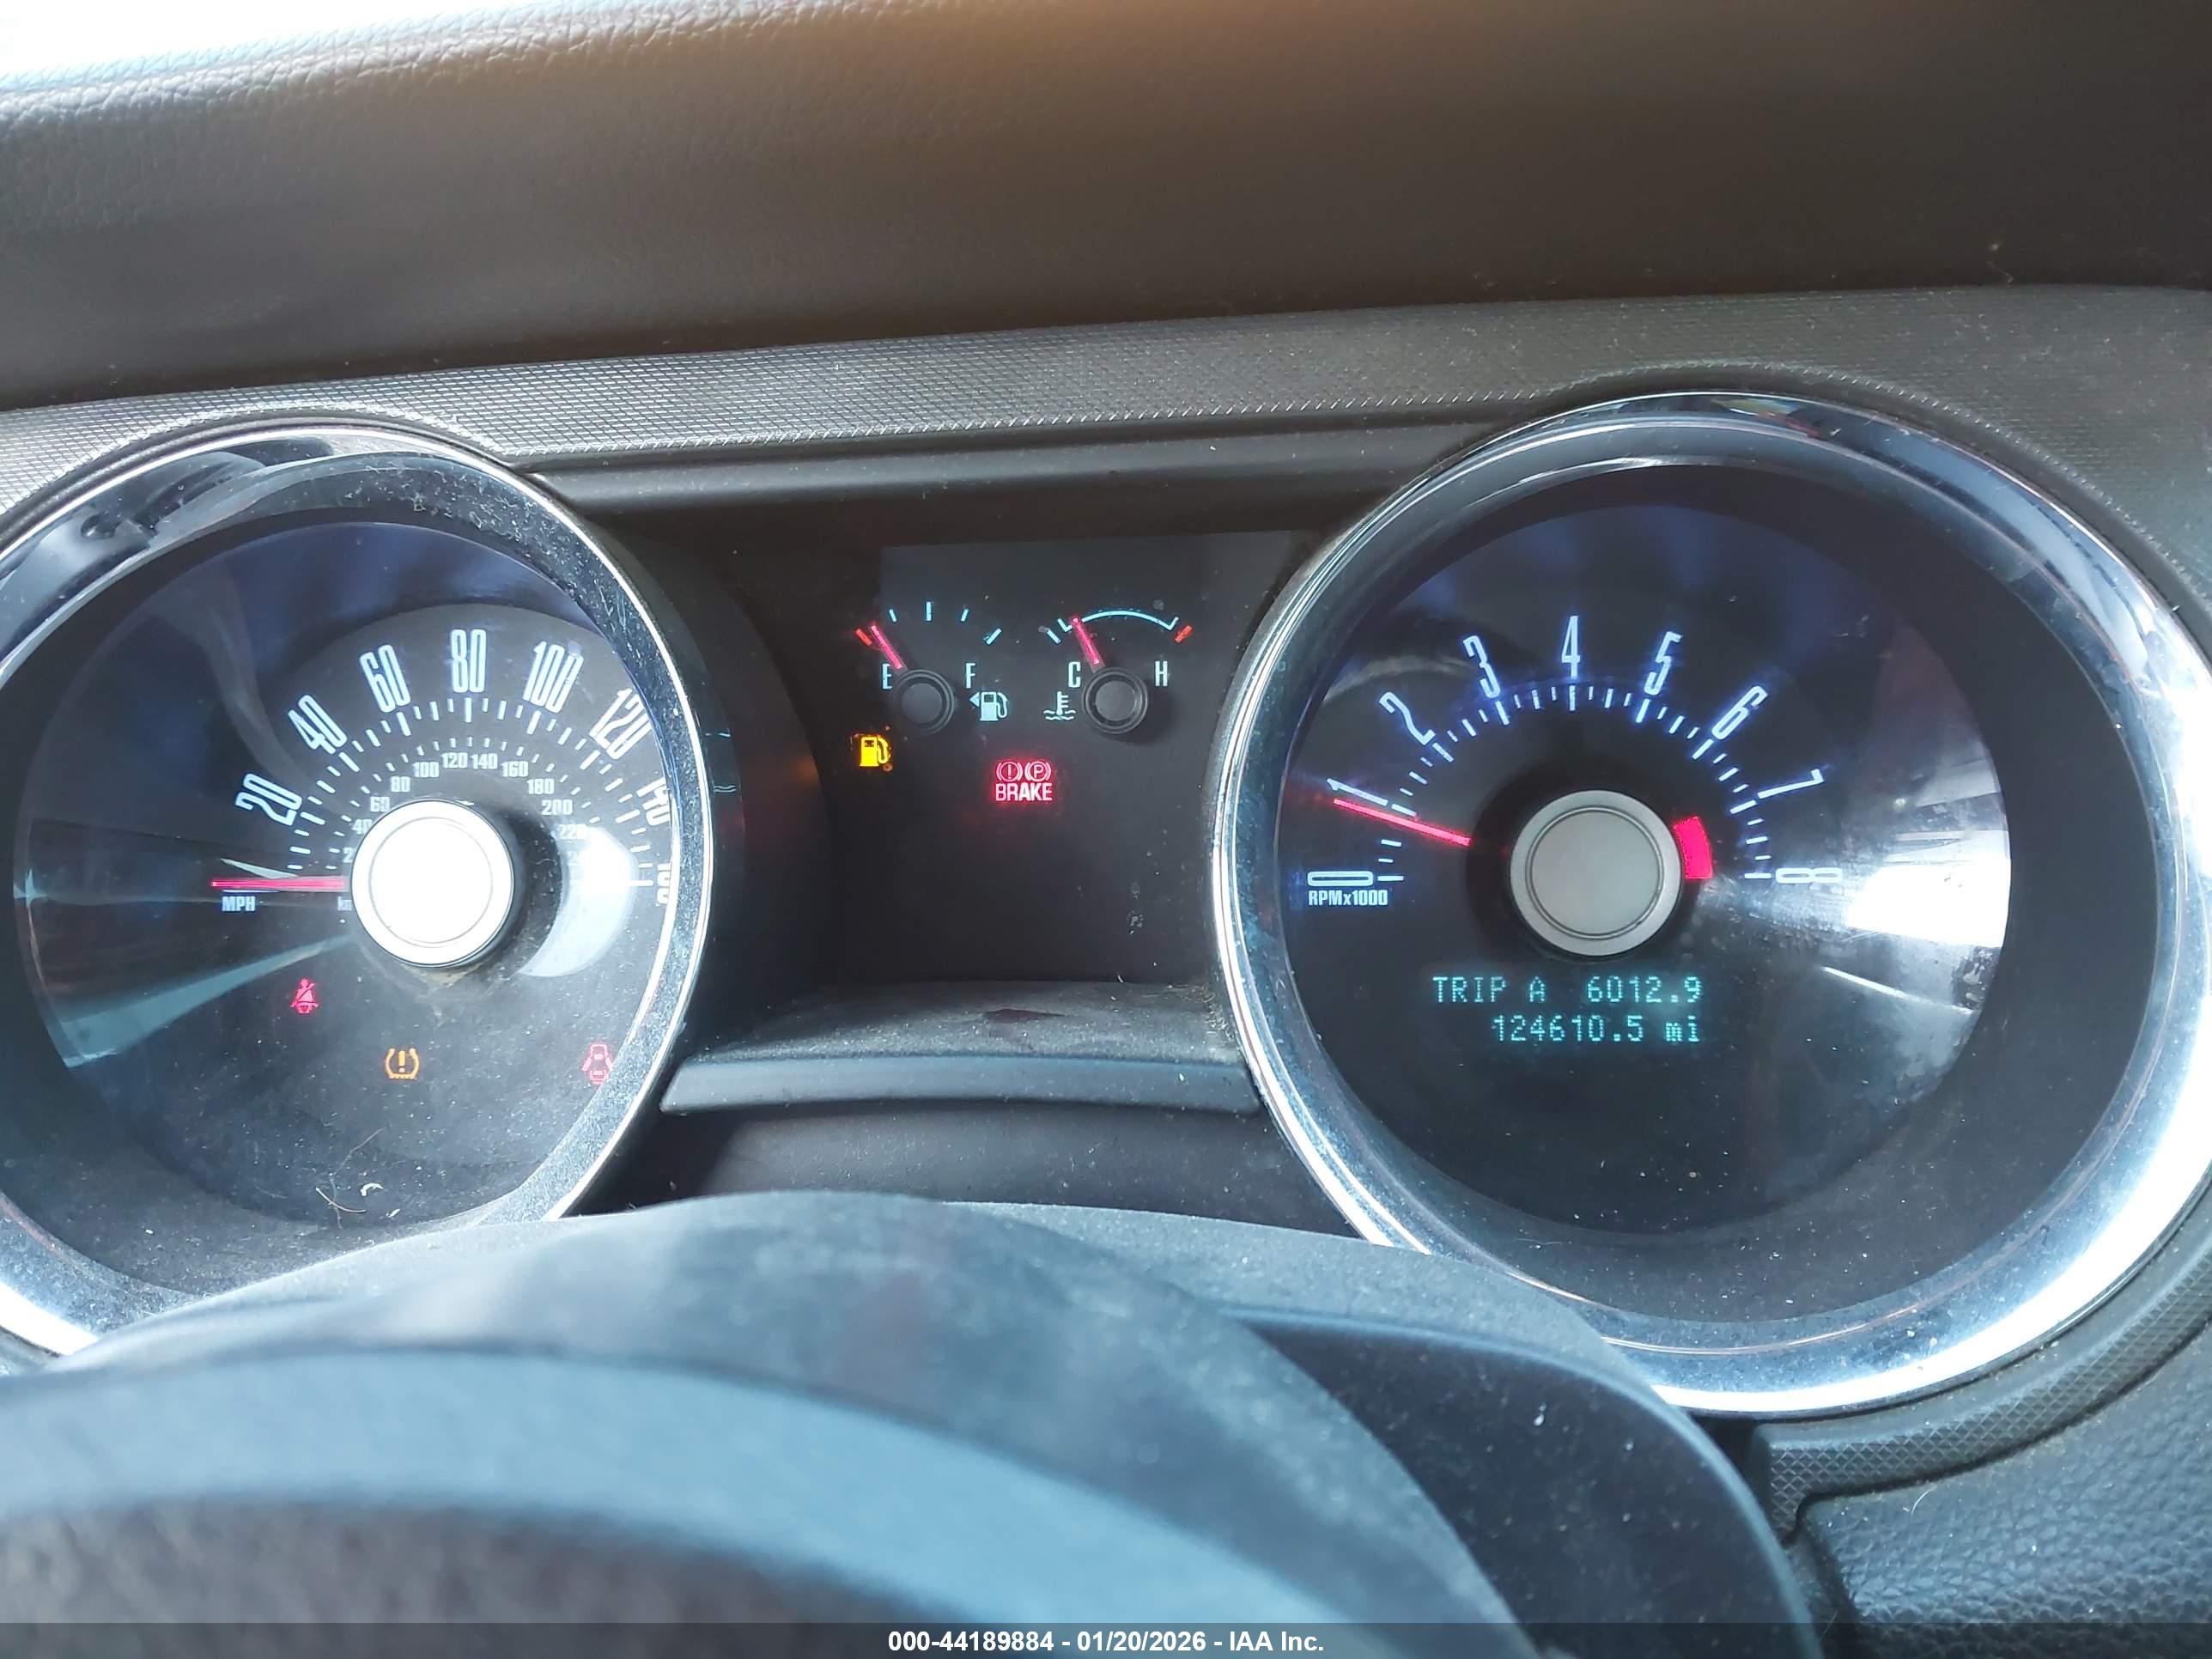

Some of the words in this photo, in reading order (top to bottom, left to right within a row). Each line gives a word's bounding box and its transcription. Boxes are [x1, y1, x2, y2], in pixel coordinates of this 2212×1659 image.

[1561, 615, 1581, 677] 4
[450, 629, 487, 693] 80
[1068, 661, 1081, 688] C
[1155, 660, 1168, 687] H
[1463, 635, 1501, 697] 3
[1644, 630, 1683, 696] 5
[360, 645, 411, 713] 60
[523, 641, 585, 713] 100
[882, 663, 893, 690] E
[966, 663, 976, 689] F
[288, 695, 348, 754] 40
[589, 688, 652, 759] 120
[1379, 691, 1435, 745] 2
[1713, 685, 1767, 740] 6
[412, 762, 440, 777] 100
[441, 752, 468, 769] 120
[471, 753, 498, 769] 140
[501, 761, 529, 777] 160
[390, 776, 410, 793] 80
[526, 778, 555, 795] 180
[996, 783, 1053, 801] BRAKE
[1327, 777, 1388, 805] 1
[1758, 769, 1826, 799] 7
[235, 773, 301, 826] 20
[541, 799, 574, 815] 200
[343, 848, 353, 863] 2
[1307, 871, 1373, 887] 0
[1776, 867, 1843, 884] 8
[222, 896, 256, 912] MPH
[1308, 889, 1388, 906] RPMx1000
[1432, 976, 1505, 1003] TRIP
[1529, 976, 1546, 1003] A
[1587, 975, 1703, 1003] 6012.9
[1494, 1014, 1644, 1042] 124610.5
[1665, 1015, 1700, 1042] mi
